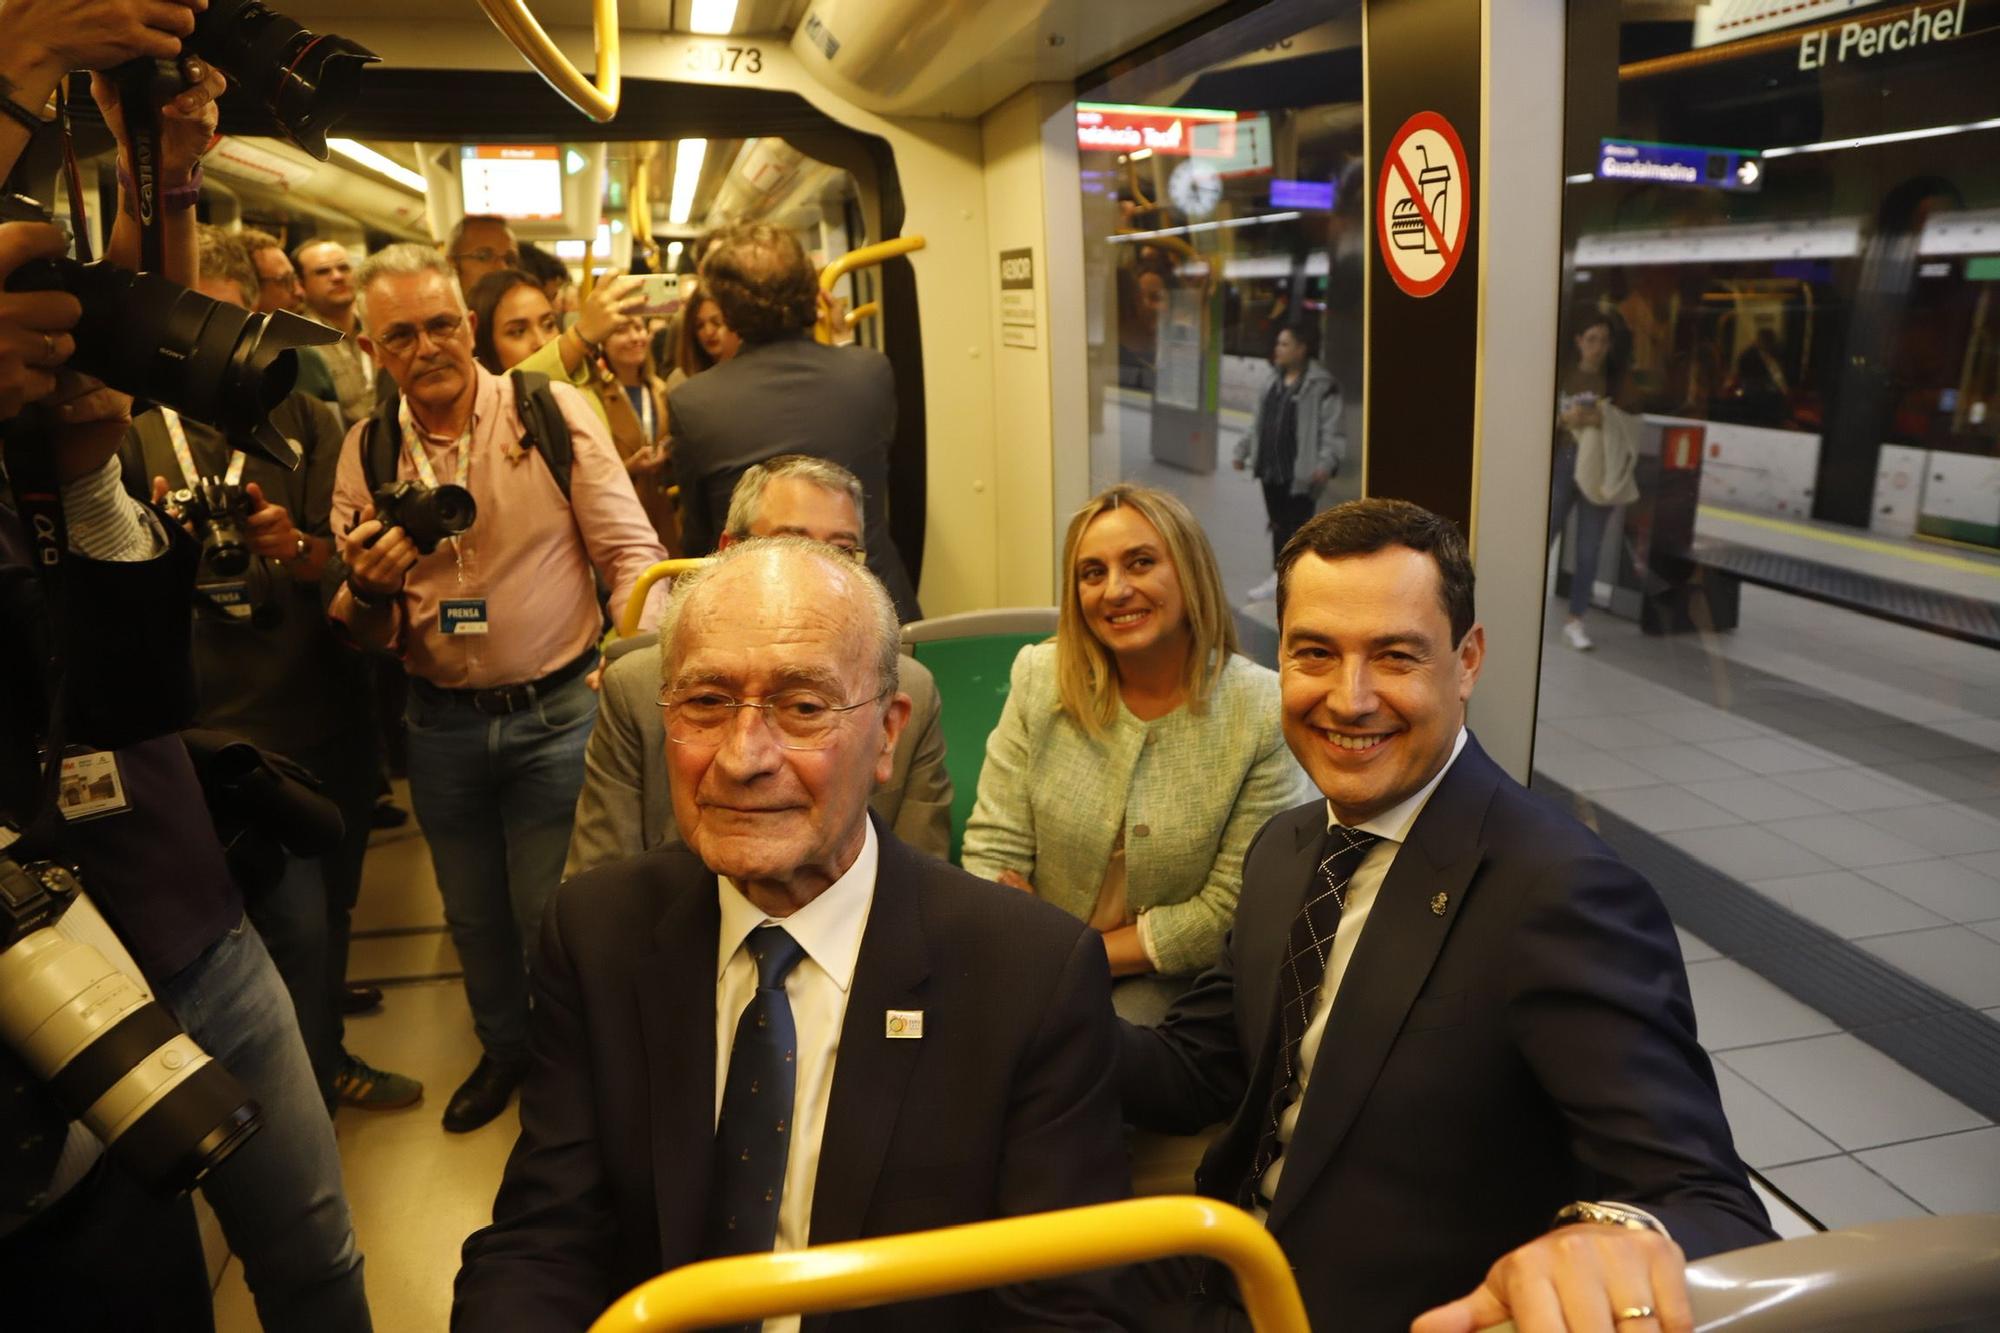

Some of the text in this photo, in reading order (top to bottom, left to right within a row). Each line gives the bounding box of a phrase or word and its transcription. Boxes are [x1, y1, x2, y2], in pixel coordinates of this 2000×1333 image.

[1798, 0, 1966, 71] El Perchel
[447, 607, 480, 617] PRENSA
